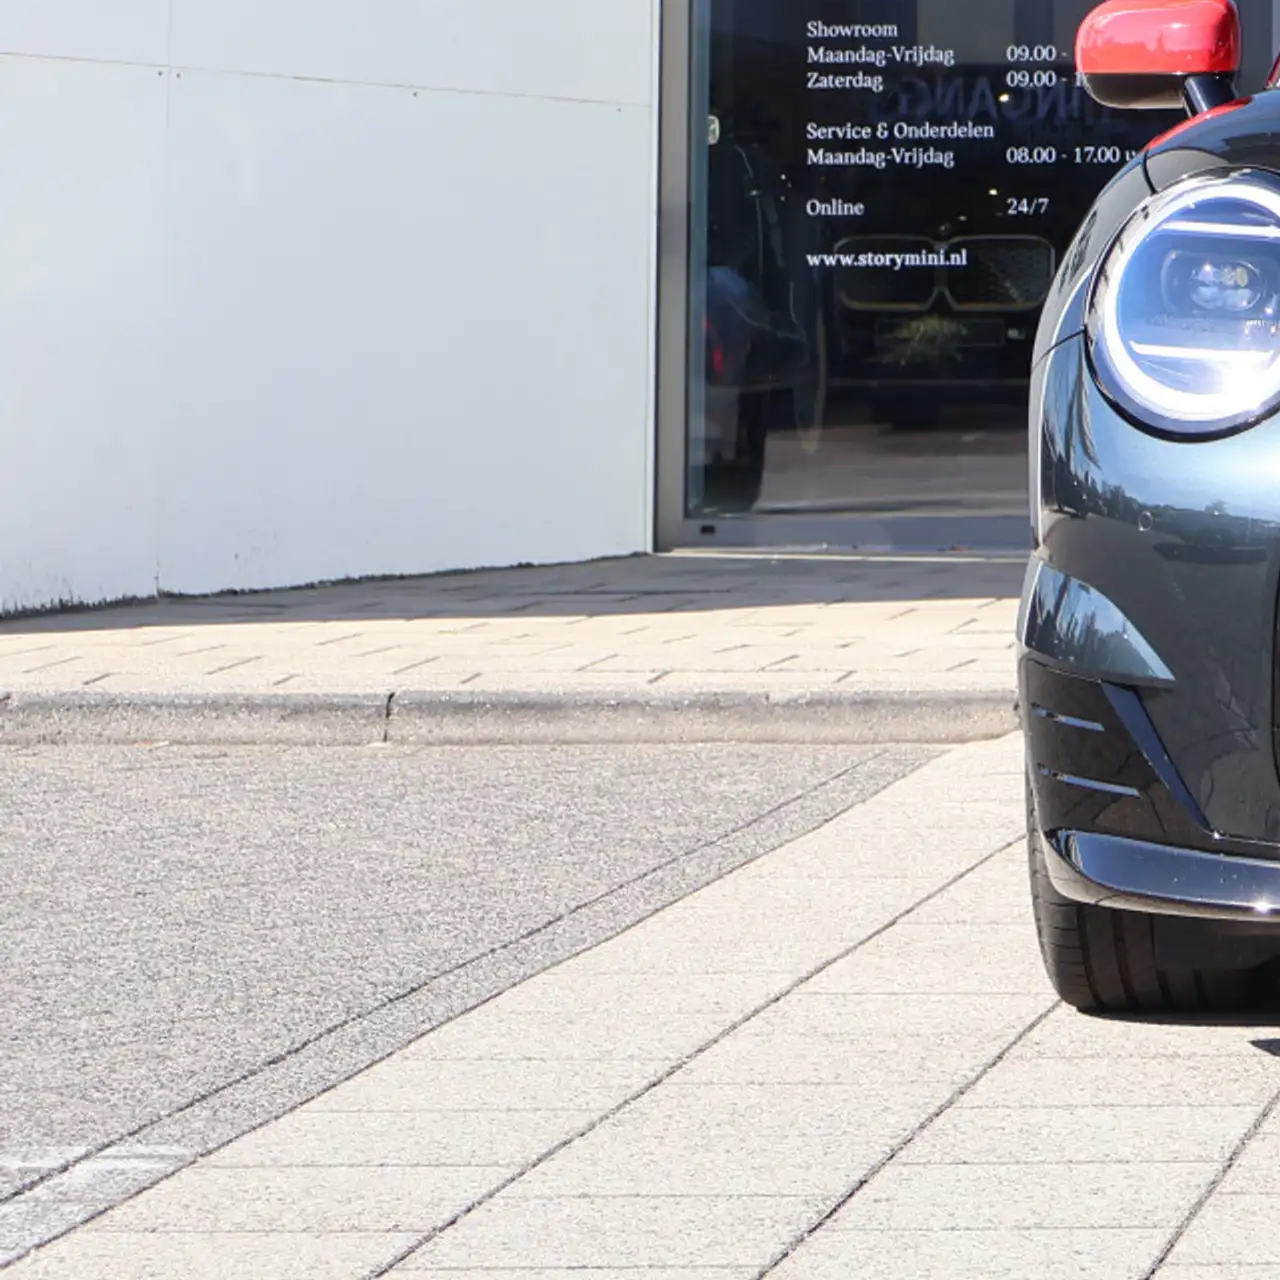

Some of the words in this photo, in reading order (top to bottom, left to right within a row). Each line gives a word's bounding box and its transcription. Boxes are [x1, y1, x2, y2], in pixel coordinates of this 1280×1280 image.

[807, 21, 897, 37] Showroom
[808, 46, 954, 67] Maandag-Vrijdag
[1007, 45, 1056, 61] 09.00
[807, 71, 883, 92] Zaterdag
[1006, 71, 1056, 87] 09.00
[807, 123, 871, 139] Service
[876, 122, 888, 139] &
[894, 122, 993, 138] Onderdelen
[808, 147, 954, 169] Maandag-Vrijdag
[1006, 147, 1056, 163] 08.00
[1075, 146, 1120, 163] 17.00
[806, 199, 864, 215] Online
[1008, 198, 1049, 214] 24/7
[807, 249, 966, 270] www.storymini.nl
